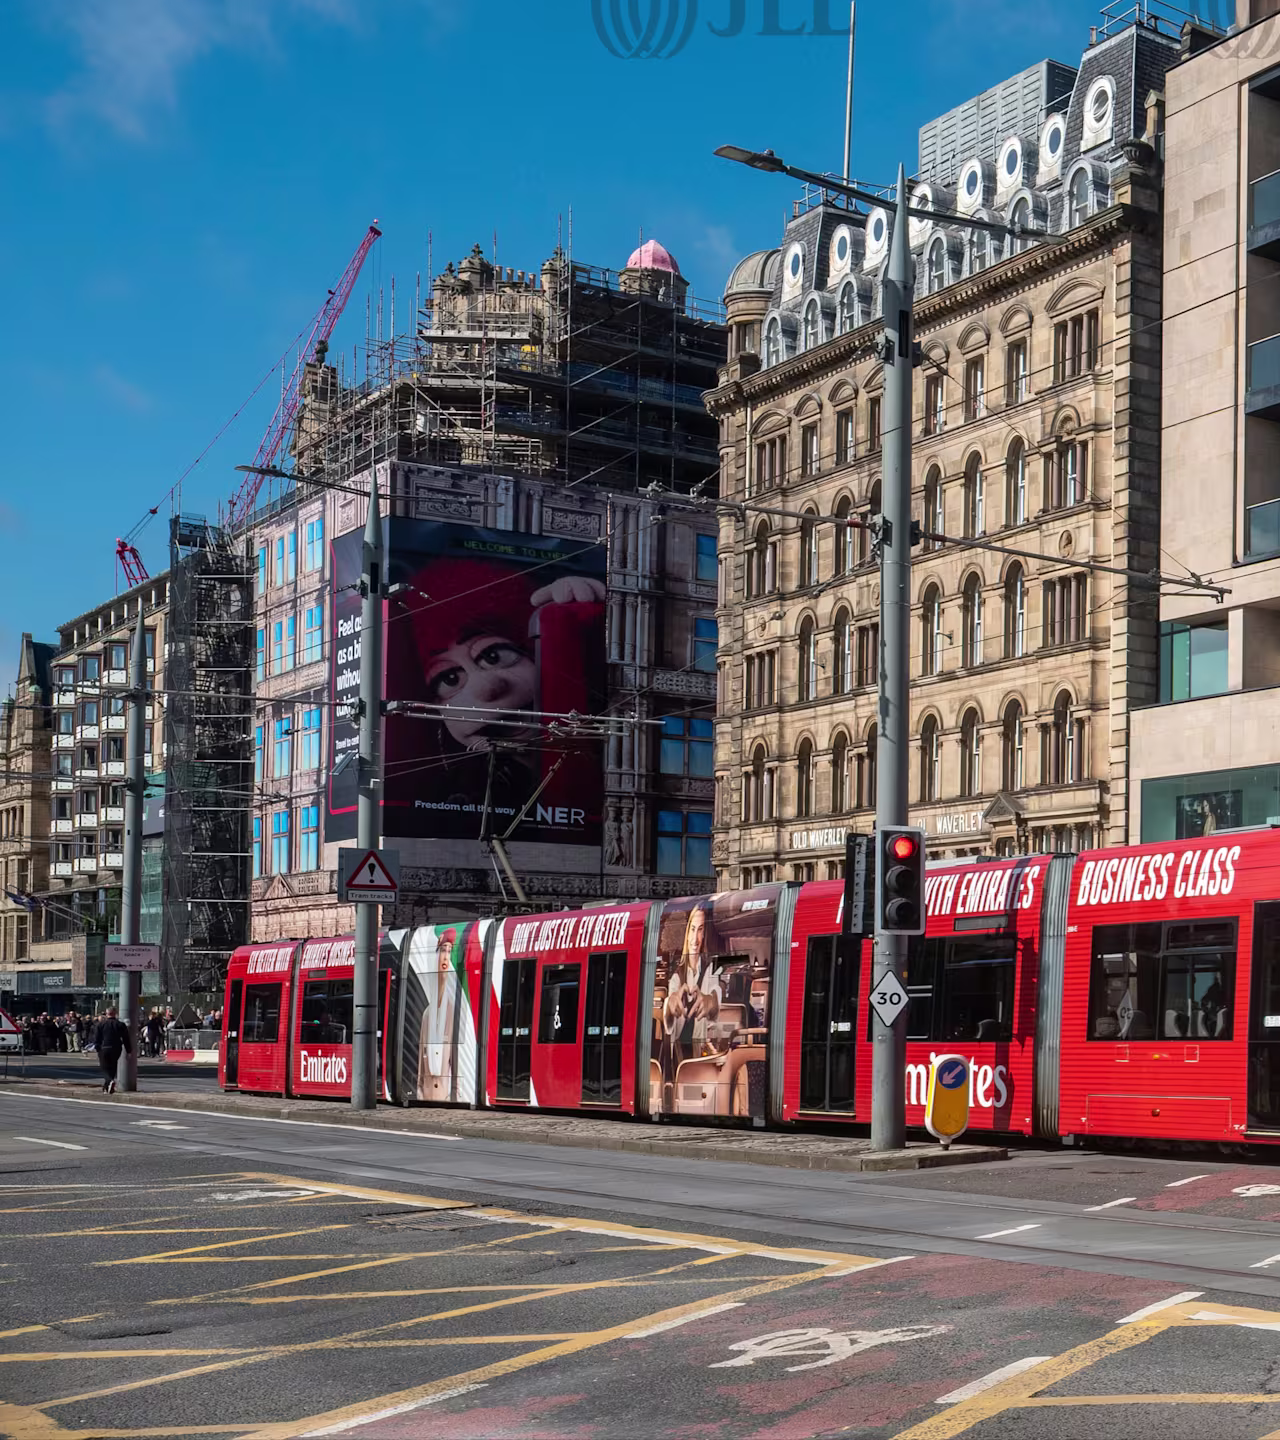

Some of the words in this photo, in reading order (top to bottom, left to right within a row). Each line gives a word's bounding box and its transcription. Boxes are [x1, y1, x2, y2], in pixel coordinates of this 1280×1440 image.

[464, 540, 515, 555] WELCOME
[521, 547, 536, 558] TO
[337, 614, 354, 638] Feel
[337, 647, 347, 665] as
[347, 645, 354, 662] a
[336, 667, 361, 691] withou
[414, 800, 461, 811] Freedom
[462, 804, 476, 812] all
[495, 807, 516, 816] way
[522, 802, 585, 825] LNER
[936, 811, 984, 834] WAVERLEY
[792, 831, 807, 849] OLD
[809, 826, 847, 847] WAVERLEY
[1076, 852, 1175, 906] BUSINESS
[1173, 845, 1241, 898] CLASS
[955, 865, 1041, 914] EMIRATES
[509, 921, 540, 954] DON'T
[534, 919, 562, 952] JUST
[575, 915, 598, 948] FLY
[591, 911, 631, 947] BETTER
[255, 948, 279, 973] BETTER
[300, 942, 333, 969] EMIRATES
[877, 992, 902, 1006] 30
[300, 1048, 348, 1084] Emirates
